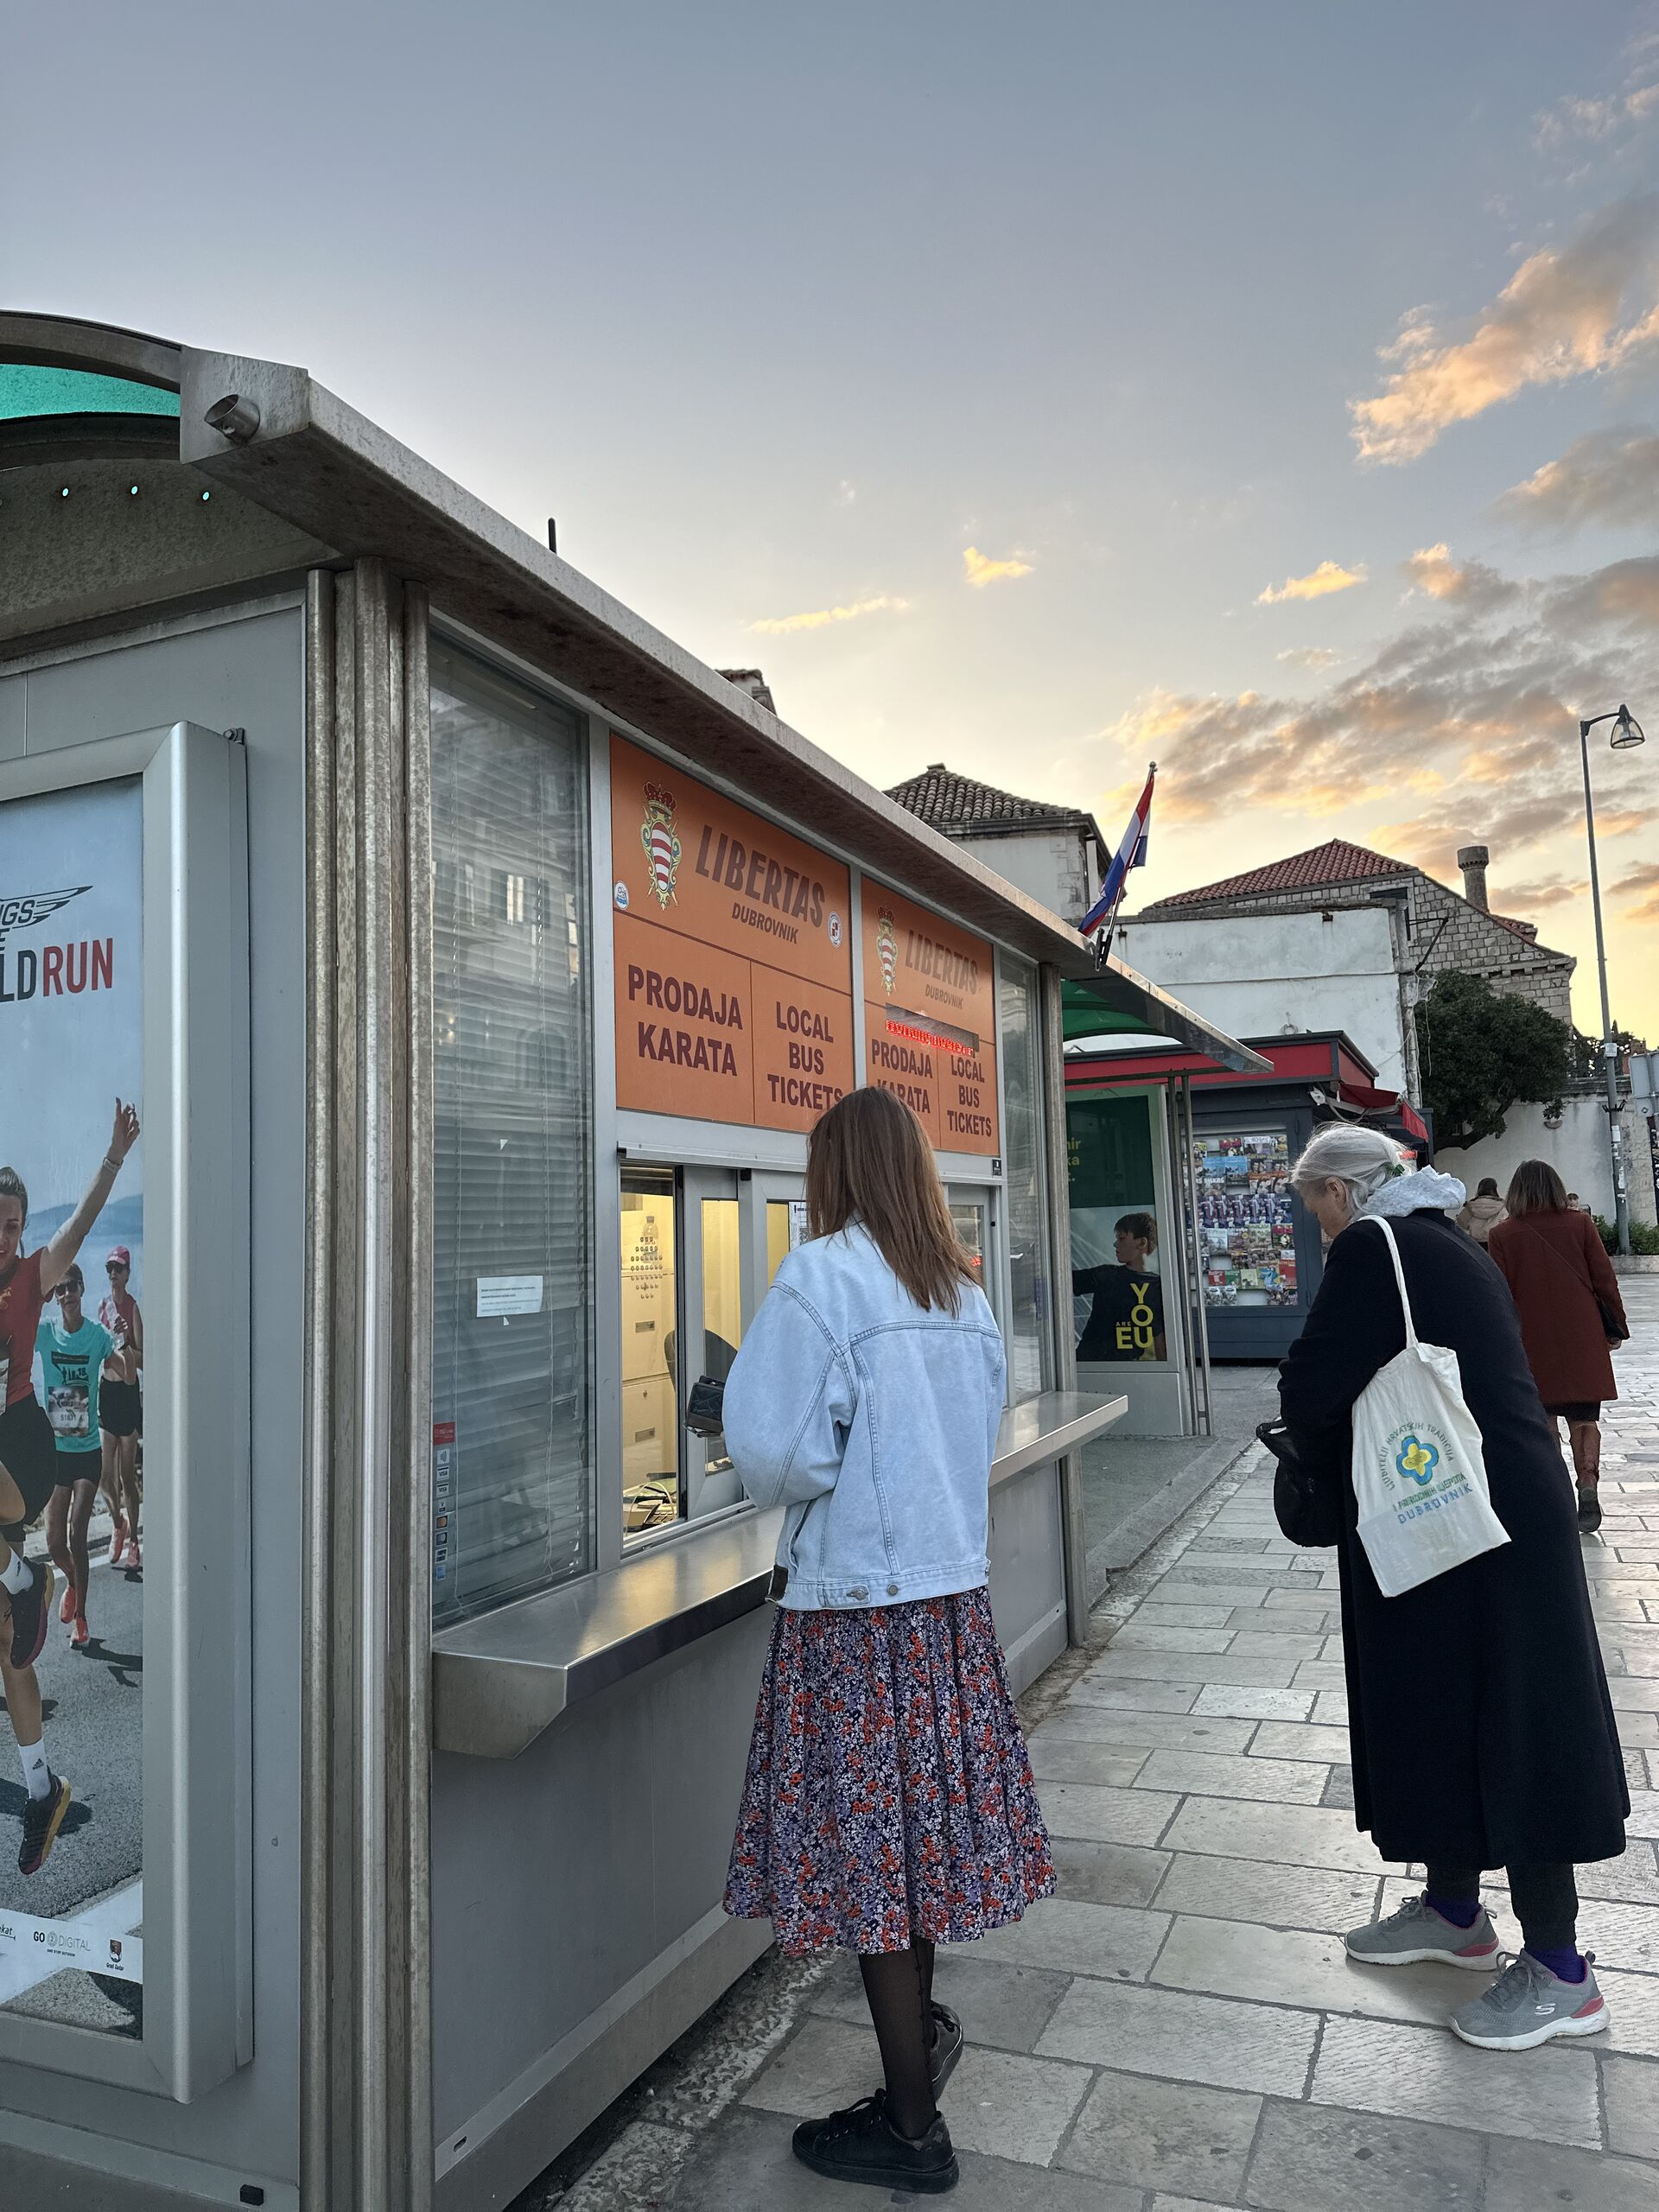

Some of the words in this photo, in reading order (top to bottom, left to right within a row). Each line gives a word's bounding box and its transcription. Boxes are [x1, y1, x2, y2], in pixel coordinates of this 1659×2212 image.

[696, 825, 825, 928] LIBERTAS
[732, 903, 799, 944] DUBROVNIK
[906, 930, 978, 995] LIBERTAS
[628, 964, 743, 1030] PRODAJA
[925, 984, 963, 1009] DUBROVNIK
[776, 1001, 834, 1043] LOCAL
[638, 1021, 737, 1077] KARATA
[789, 1041, 824, 1075] BUS
[872, 1039, 933, 1078] PRODAJA
[951, 1055, 985, 1083] LOCAL
[959, 1084, 980, 1108] BUS
[947, 1110, 992, 1137] TICKETS
[1397, 1483, 1473, 1524] DUBROVNIK
[0, 1923, 13, 1936] kat
[34, 1931, 45, 1942] GO
[58, 1935, 91, 1952] DIGITAL
